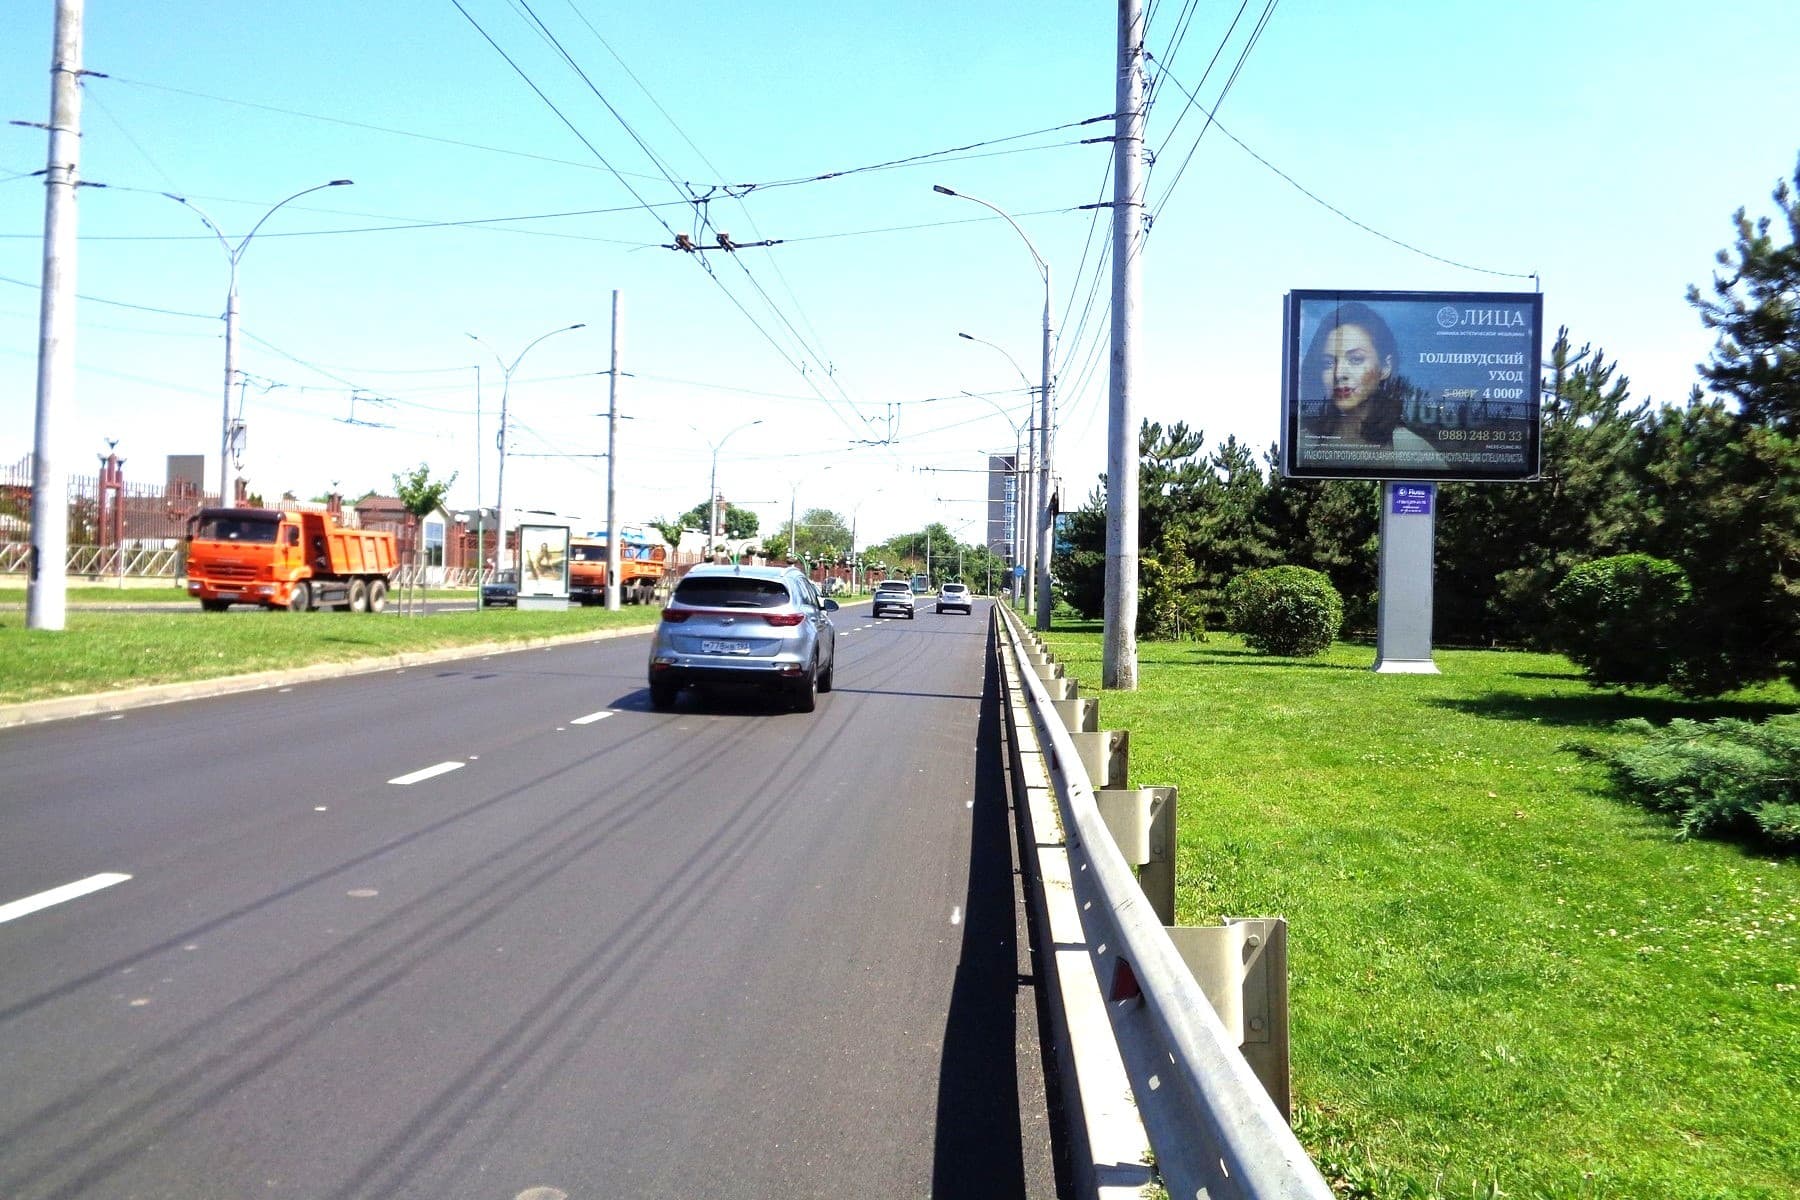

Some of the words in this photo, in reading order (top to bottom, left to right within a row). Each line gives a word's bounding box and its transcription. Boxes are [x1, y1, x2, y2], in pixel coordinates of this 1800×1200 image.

[1461, 309, 1525, 328] ЛИЦА
[1419, 352, 1524, 366] ГОЛЛИВУДСКИЙ
[1488, 370, 1523, 383] УХОД
[1438, 430, 1467, 441] (988)
[1469, 430, 1490, 441] 248
[1492, 431, 1506, 441] 30
[1508, 431, 1522, 441] 33
